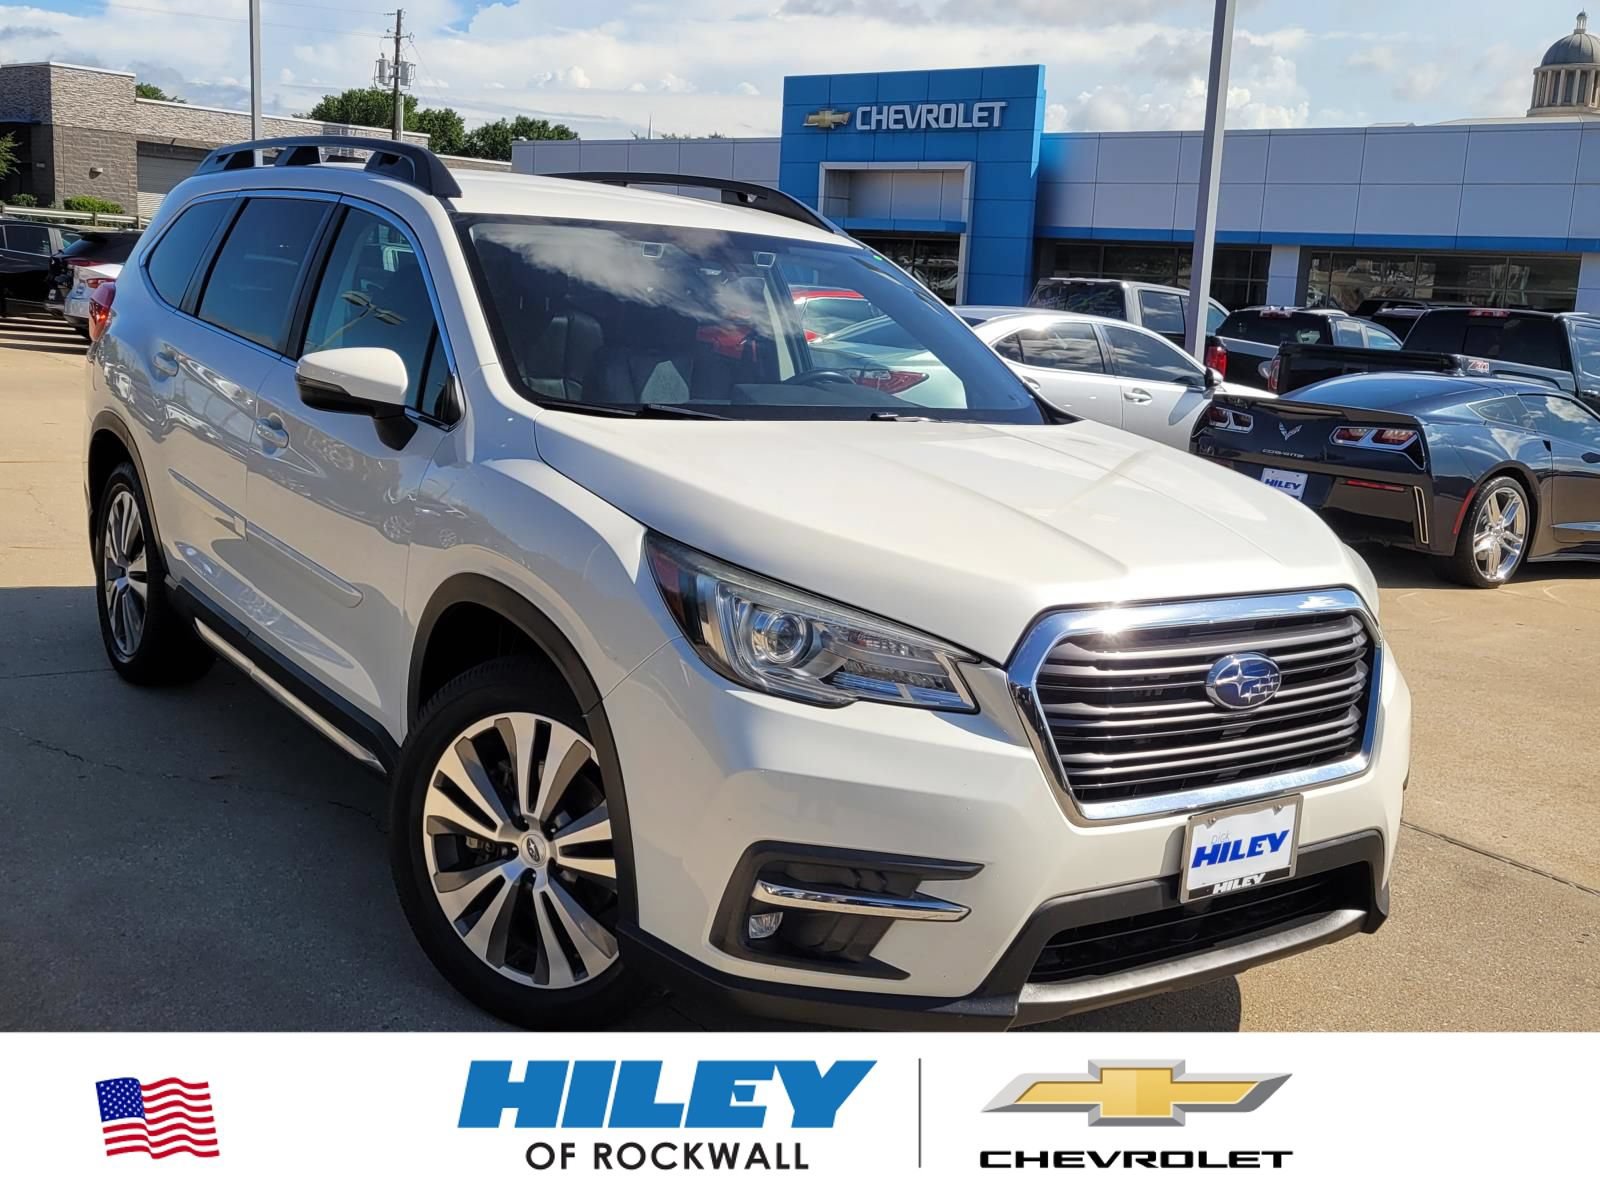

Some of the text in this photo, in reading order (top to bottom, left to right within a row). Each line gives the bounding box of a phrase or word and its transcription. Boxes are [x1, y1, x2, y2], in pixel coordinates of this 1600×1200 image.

[856, 102, 1007, 130] CHEVROLET
[1264, 478, 1301, 490] HILEY
[1191, 829, 1290, 868] HILEY
[1212, 872, 1266, 895] HILEY
